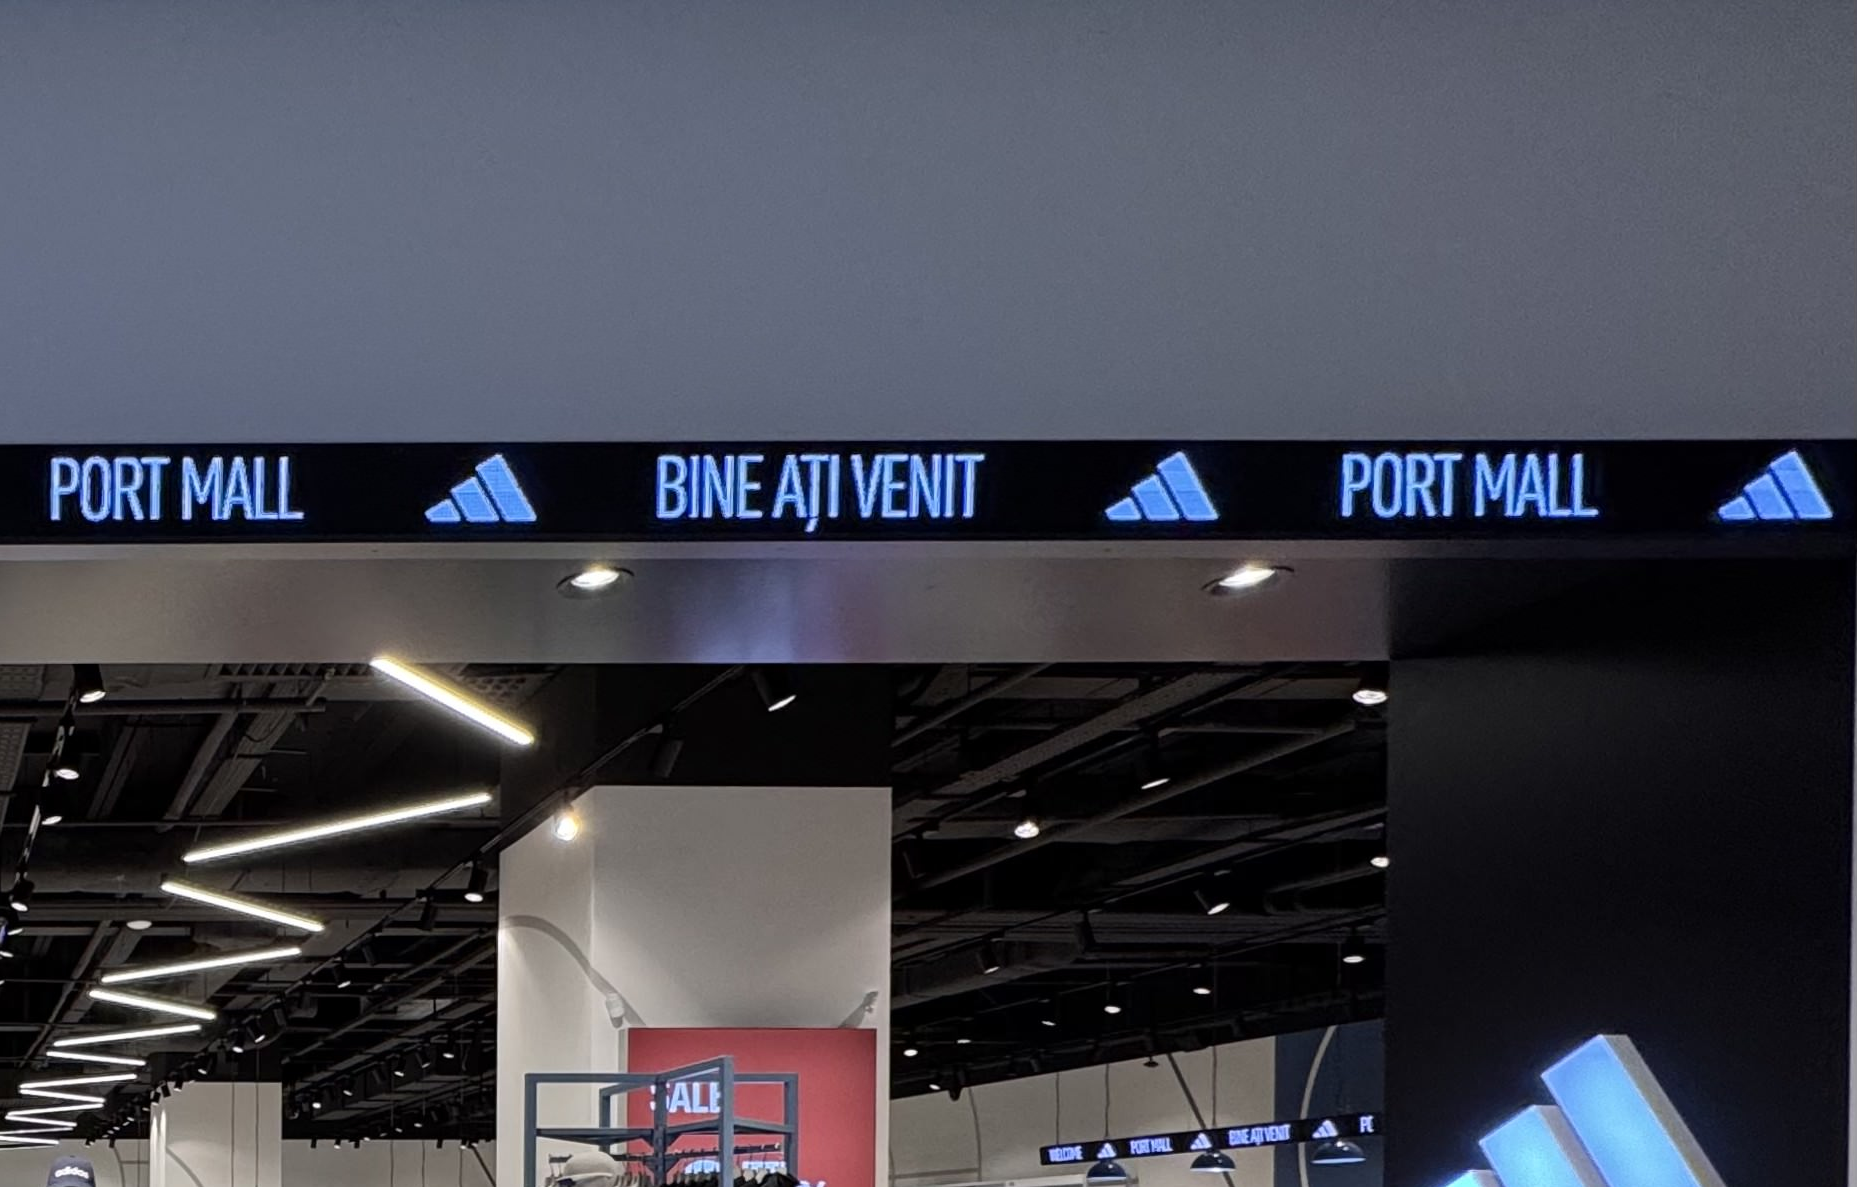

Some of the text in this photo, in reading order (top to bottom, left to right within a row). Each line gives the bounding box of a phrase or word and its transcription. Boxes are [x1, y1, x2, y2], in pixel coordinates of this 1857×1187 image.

[50, 455, 303, 522] PORT MALL
[656, 454, 764, 519] BINE
[850, 453, 985, 519] VENIT
[1340, 453, 1599, 519] PORT MALL
[1129, 1137, 1173, 1154] PORT MALL
